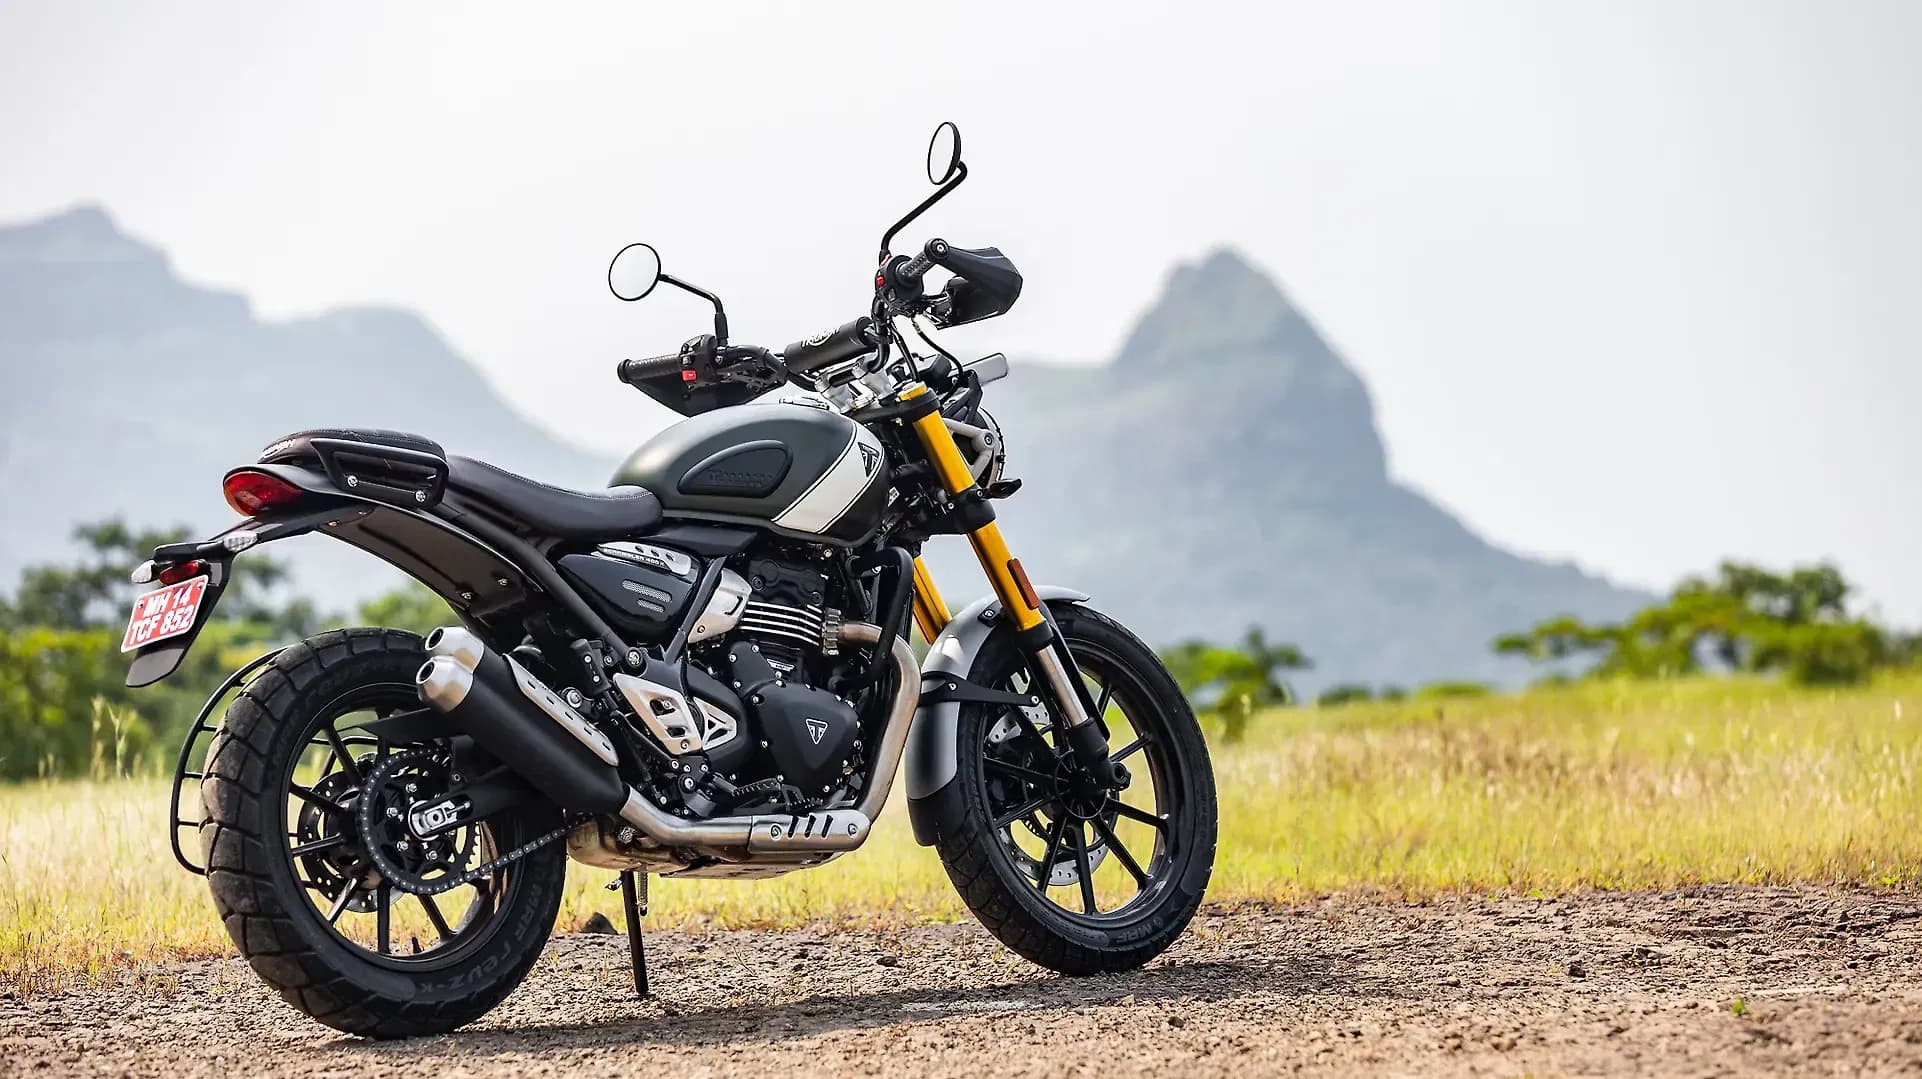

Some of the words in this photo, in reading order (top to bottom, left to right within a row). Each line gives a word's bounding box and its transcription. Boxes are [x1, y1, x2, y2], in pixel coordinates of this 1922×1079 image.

[143, 592, 171, 617] MH
[172, 584, 193, 609] 14
[130, 614, 161, 644] TCF
[159, 605, 195, 635] 852
